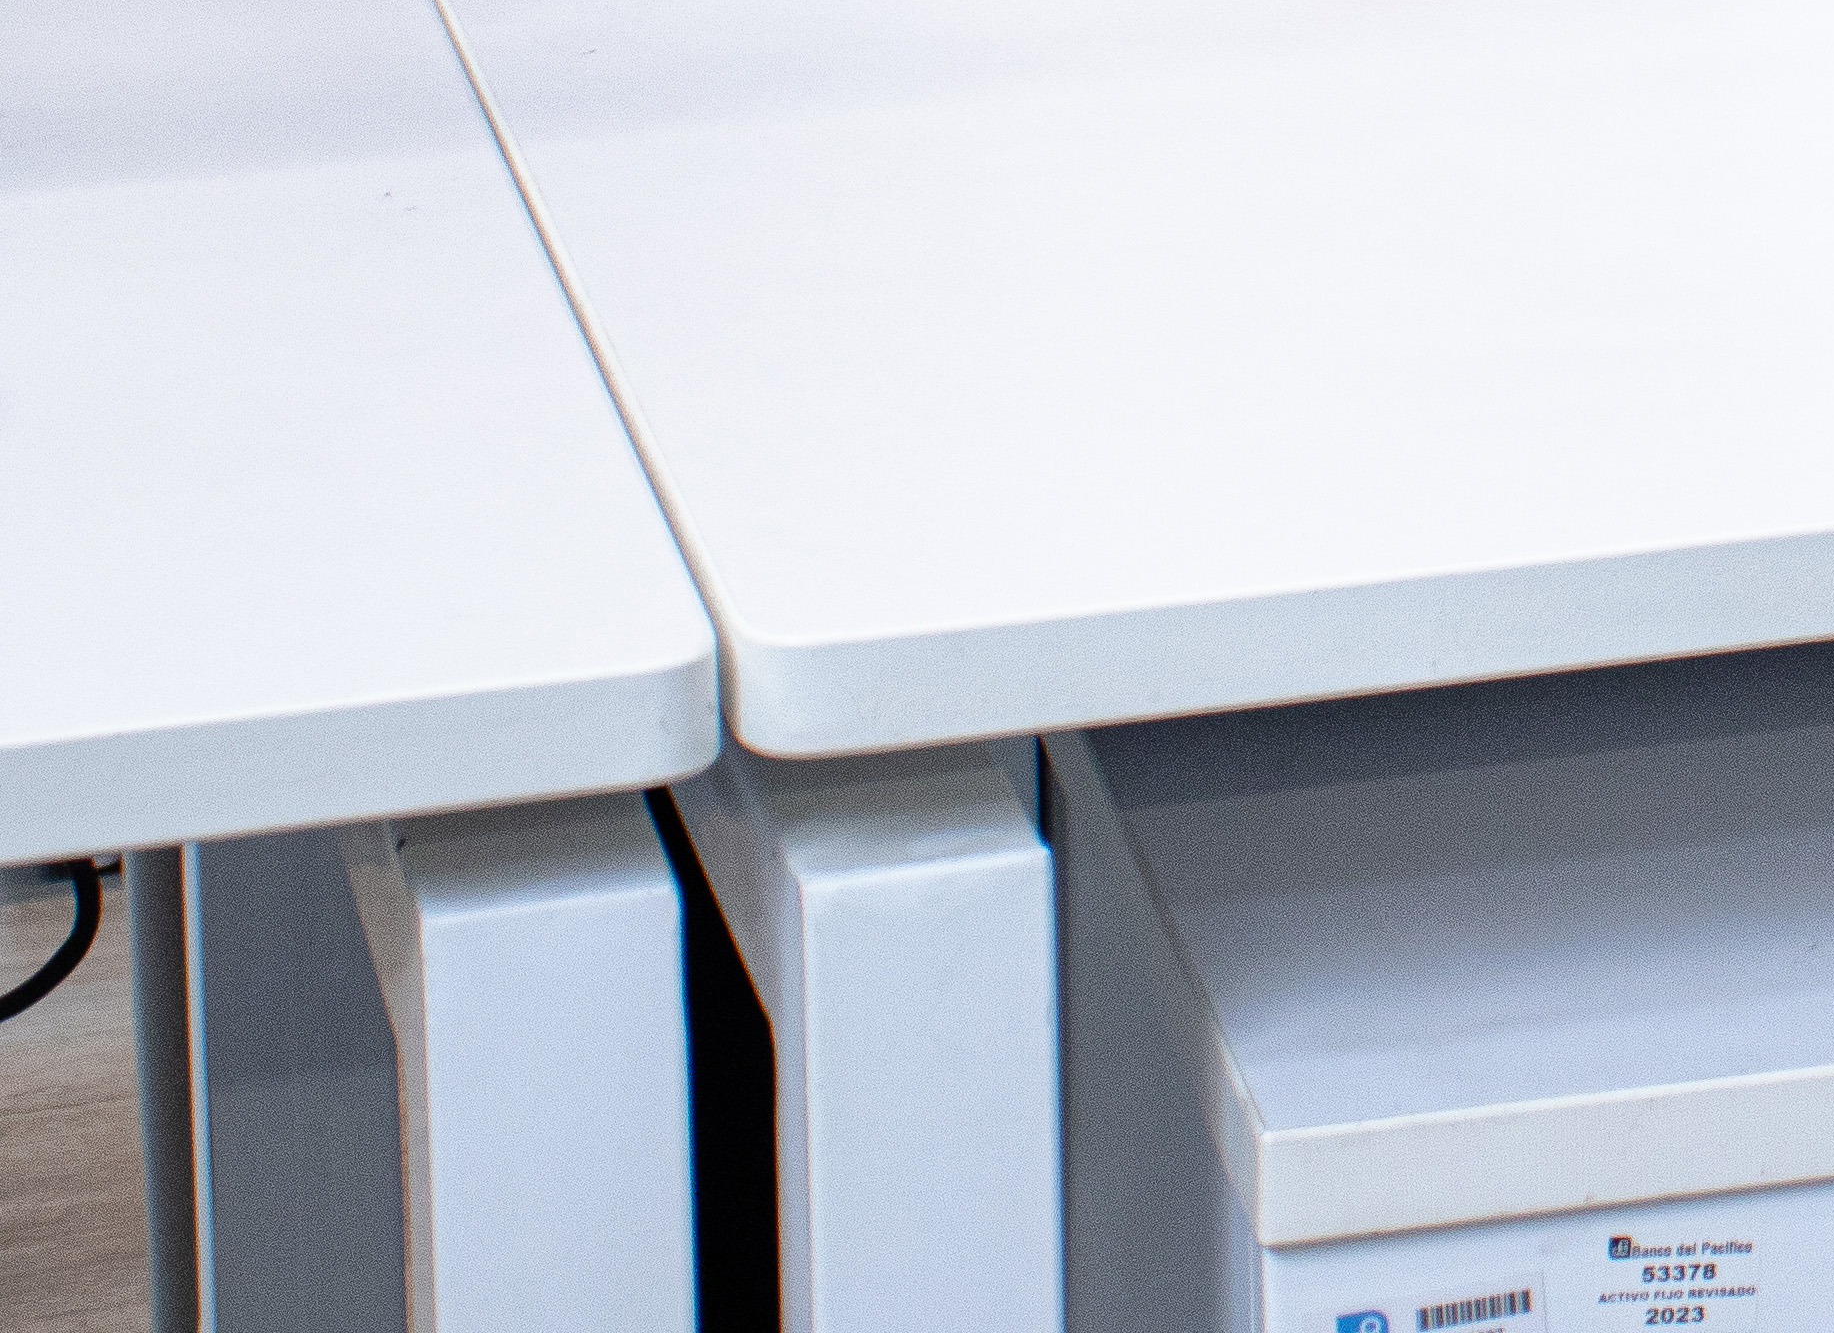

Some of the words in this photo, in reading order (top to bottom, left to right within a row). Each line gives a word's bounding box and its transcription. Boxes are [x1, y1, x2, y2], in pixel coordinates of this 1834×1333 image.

[1631, 1243, 1672, 1259] Banco
[1676, 1241, 1697, 1257] del
[1642, 1263, 1717, 1283] 53378
[1598, 1292, 1650, 1304] ACTIVO
[1653, 1289, 1684, 1301] FIJO
[1688, 1286, 1757, 1299] REVISADO
[1645, 1305, 1706, 1326] 2023
